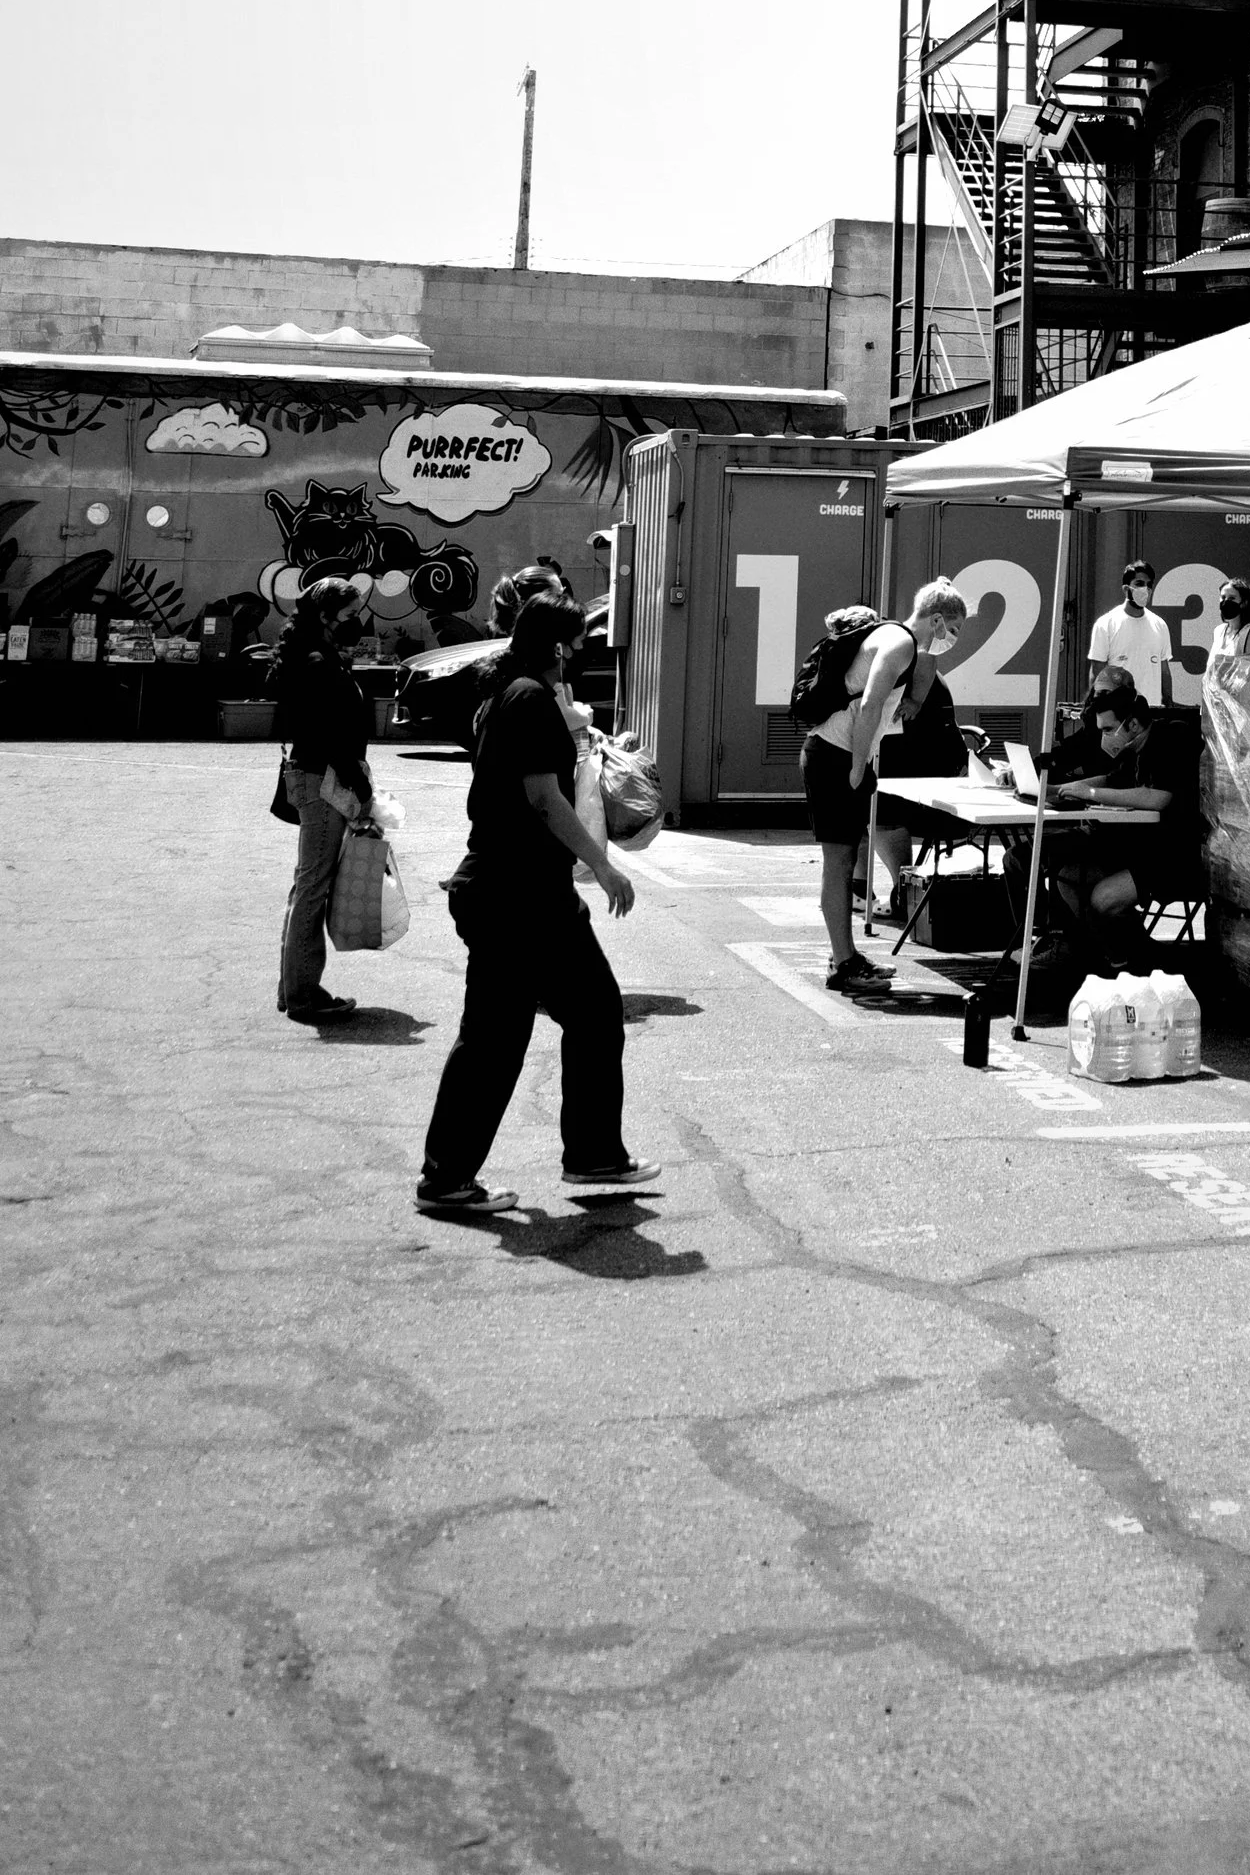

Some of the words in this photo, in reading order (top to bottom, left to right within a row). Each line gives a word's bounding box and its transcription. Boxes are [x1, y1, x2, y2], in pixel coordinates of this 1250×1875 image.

[407, 435, 524, 462] PURRFECT!
[413, 462, 471, 479] PARKING
[820, 504, 864, 516] CHARGE
[1027, 509, 1063, 520] CHARG
[736, 555, 799, 706] 1
[938, 559, 1041, 706] 2
[1152, 563, 1232, 707] 3
